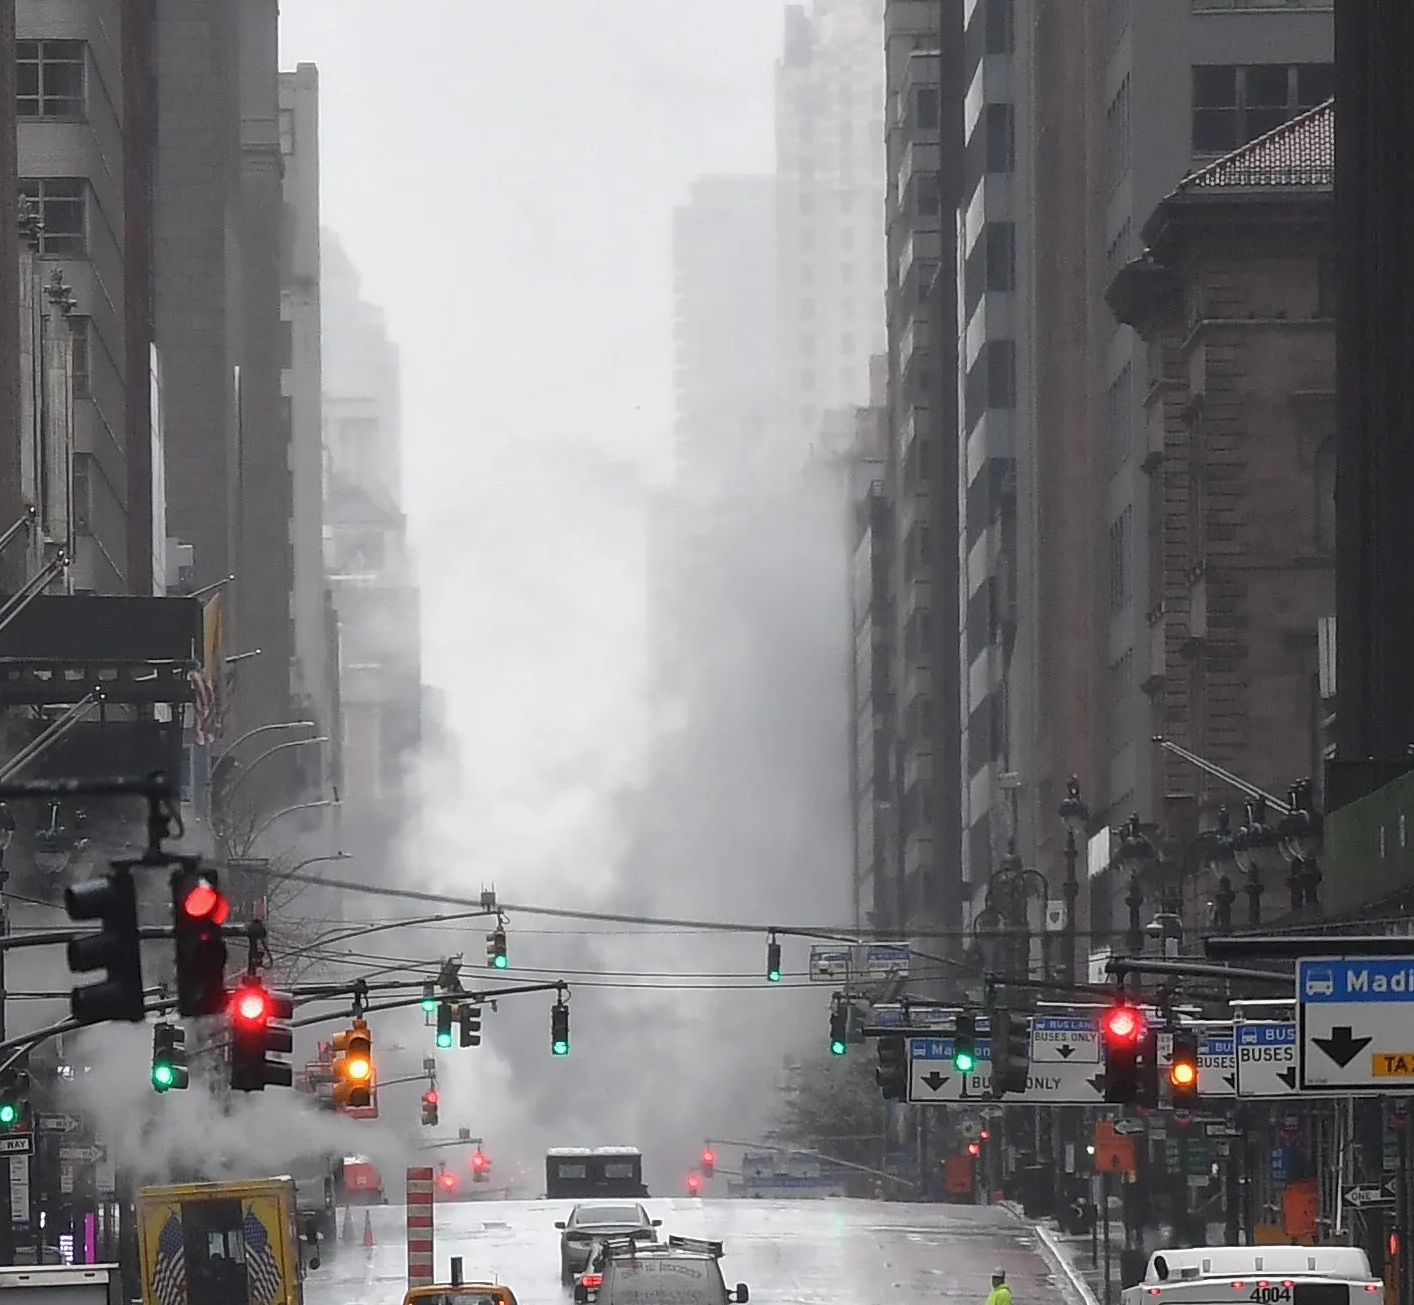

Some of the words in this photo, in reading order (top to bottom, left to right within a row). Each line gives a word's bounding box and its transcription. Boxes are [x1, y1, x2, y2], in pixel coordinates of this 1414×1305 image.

[1036, 1032, 1065, 1041] BUSES
[1071, 1032, 1097, 1041] ONLY
[1265, 1028, 1295, 1040] BUS
[931, 1044, 990, 1056] Maon
[1241, 1047, 1293, 1061] BUSES
[1198, 1056, 1234, 1067] BUSES
[1026, 1076, 1062, 1090] ONLY
[6, 1140, 26, 1149] WAY
[1250, 1286, 1291, 1303] 4004
